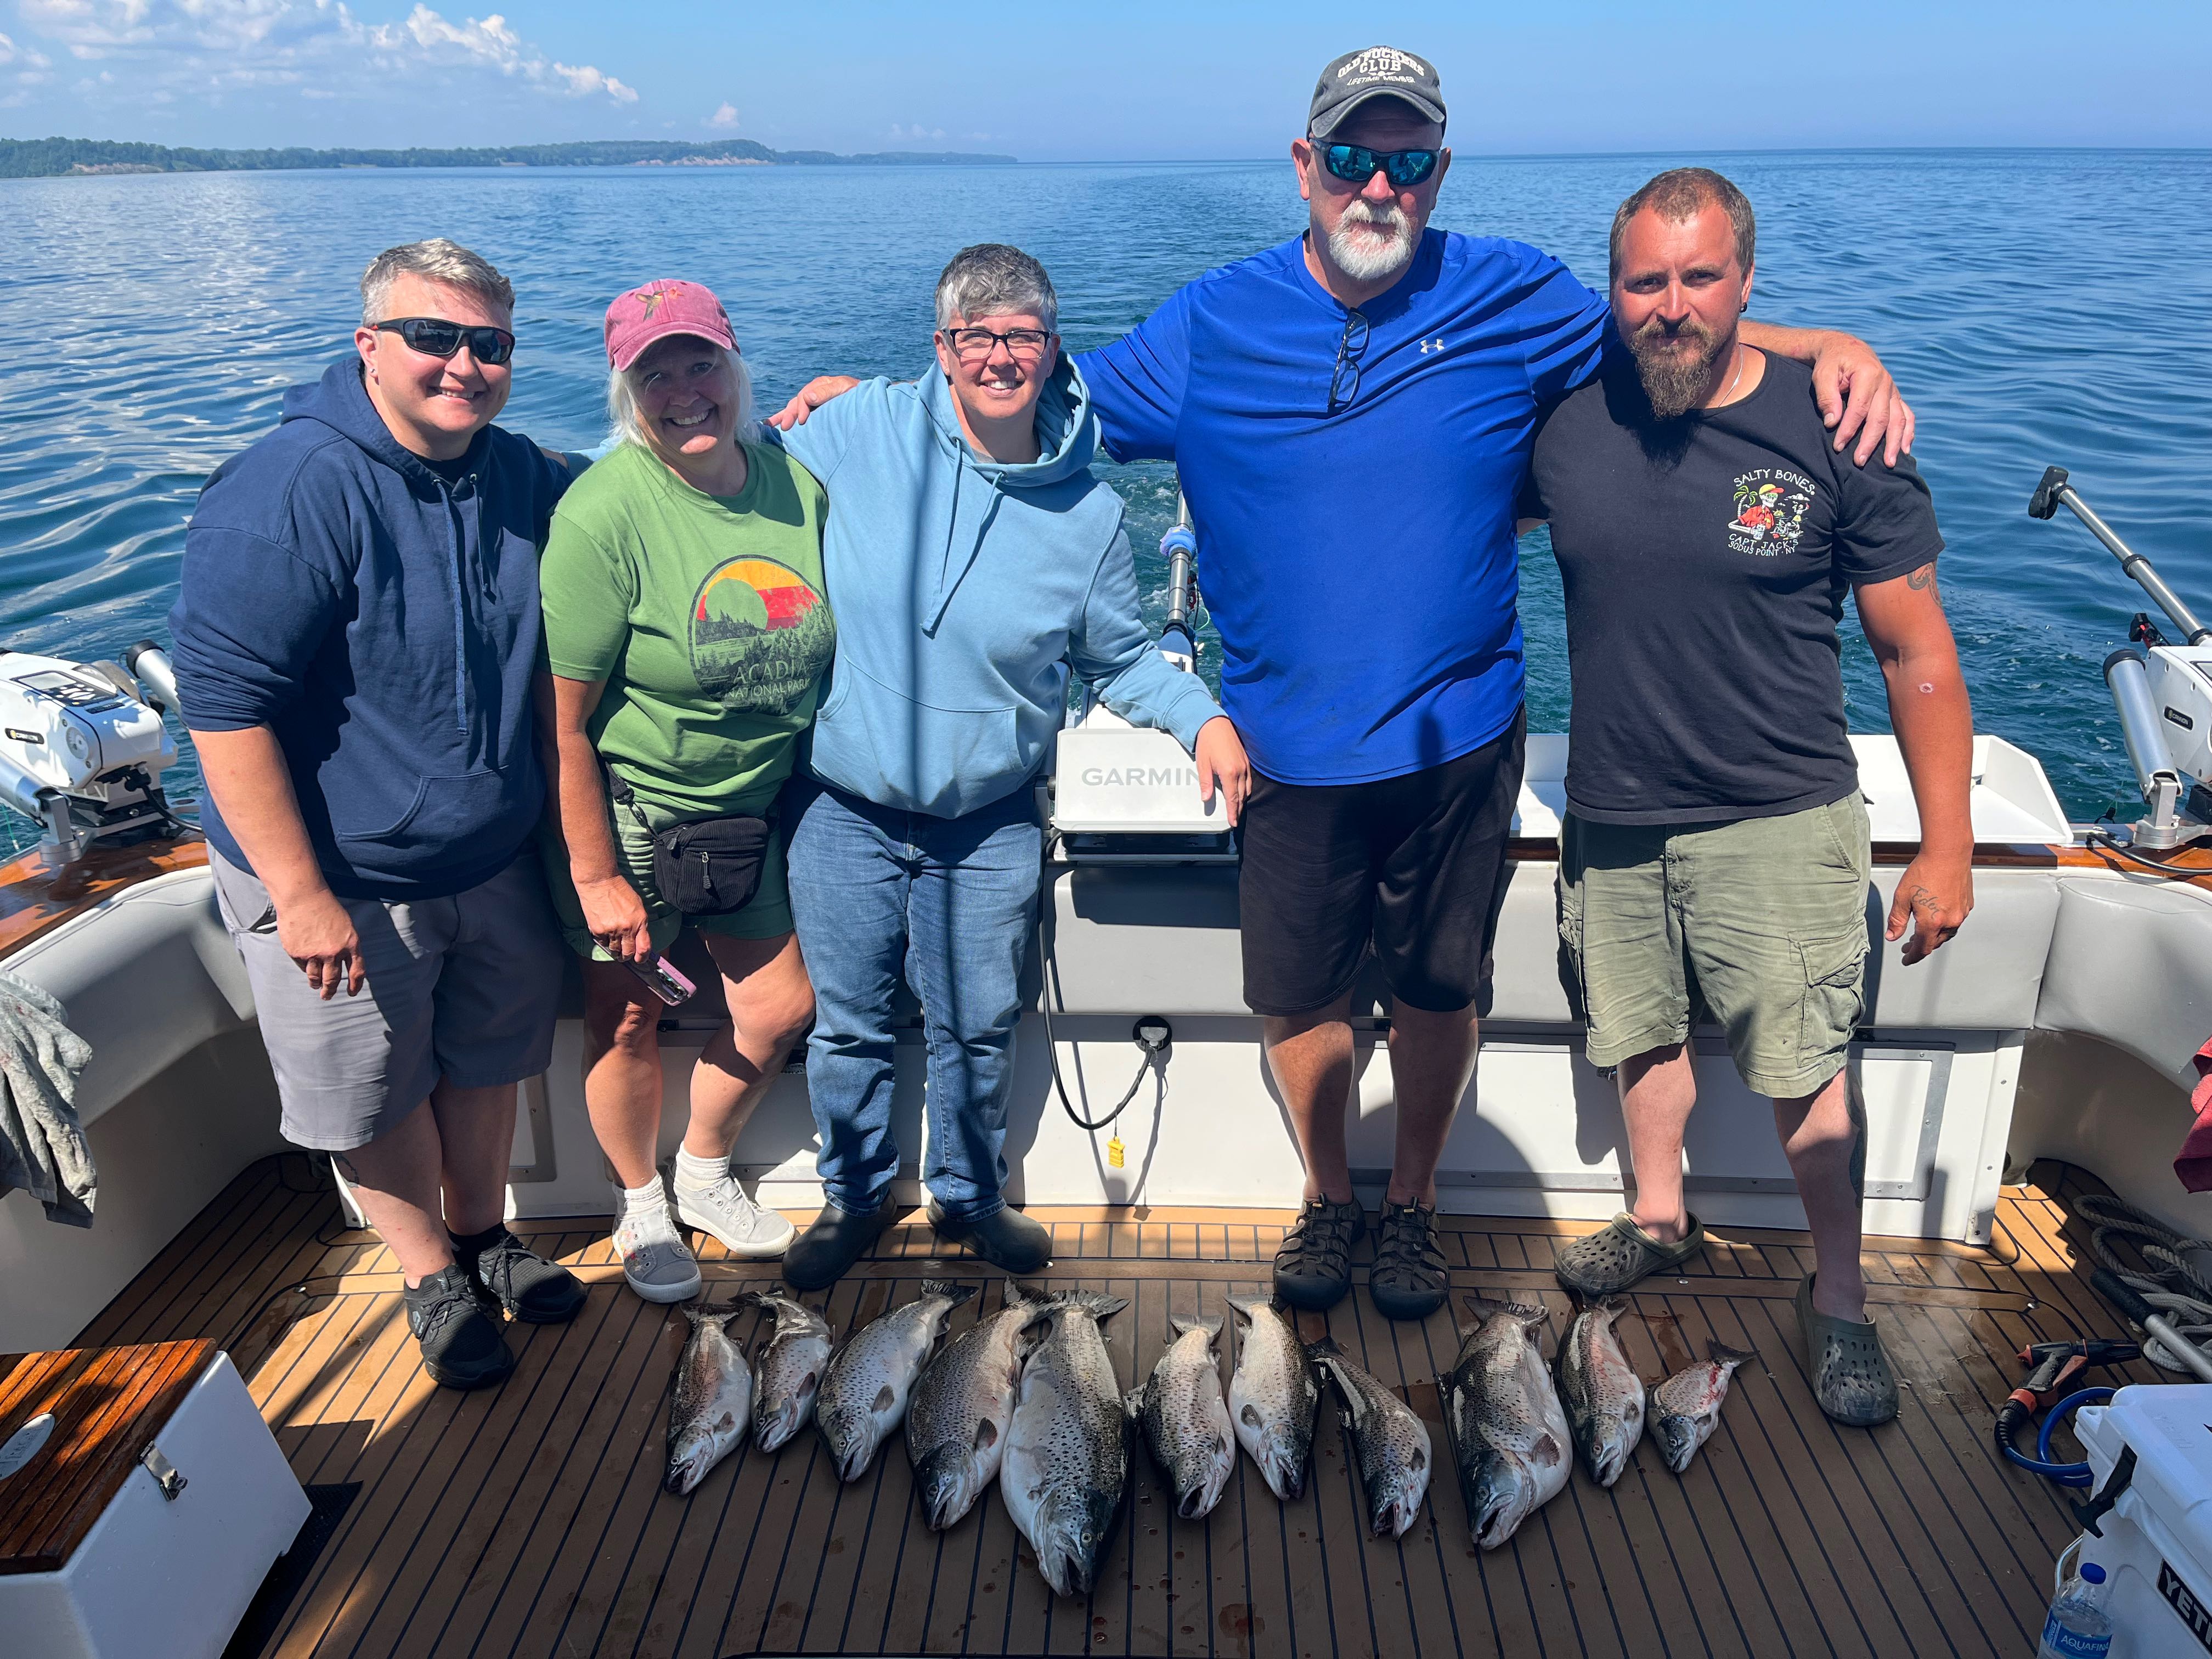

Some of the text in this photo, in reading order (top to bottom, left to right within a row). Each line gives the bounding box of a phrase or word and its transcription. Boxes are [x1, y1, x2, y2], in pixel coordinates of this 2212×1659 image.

[1338, 57, 1361, 78] OLD
[1359, 58, 1401, 73] CLUB
[1347, 76, 1379, 86] LIFETIME
[1734, 469, 1770, 487] SALTY
[1728, 541, 1754, 554] SODUS
[1729, 533, 1798, 549] CAPT JACK'S
[733, 659, 808, 684] ACADIA
[725, 678, 810, 698] NATIONAL PARK
[2165, 1568, 2212, 1645] YETI
